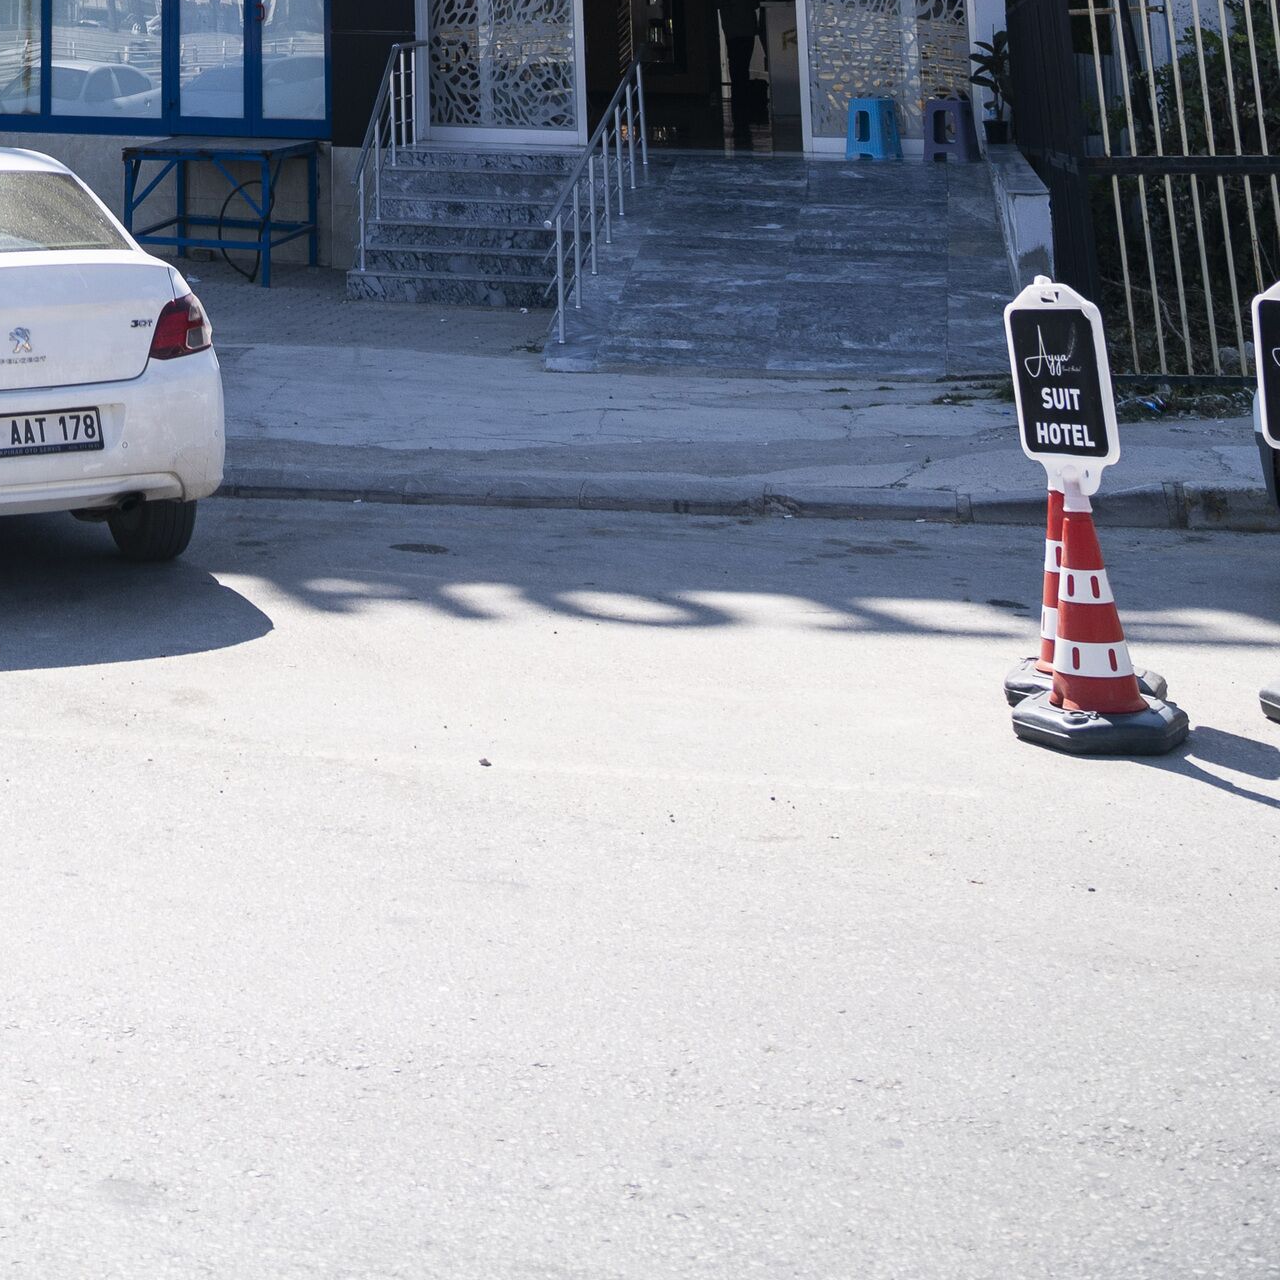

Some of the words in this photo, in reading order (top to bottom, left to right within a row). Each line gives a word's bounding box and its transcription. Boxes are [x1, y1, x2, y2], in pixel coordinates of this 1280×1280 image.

[1024, 324, 1070, 378] Ayya
[1041, 386, 1081, 411] SUIT
[11, 417, 47, 445] AAT
[58, 414, 96, 441] 178
[1035, 421, 1096, 448] HOTEL
